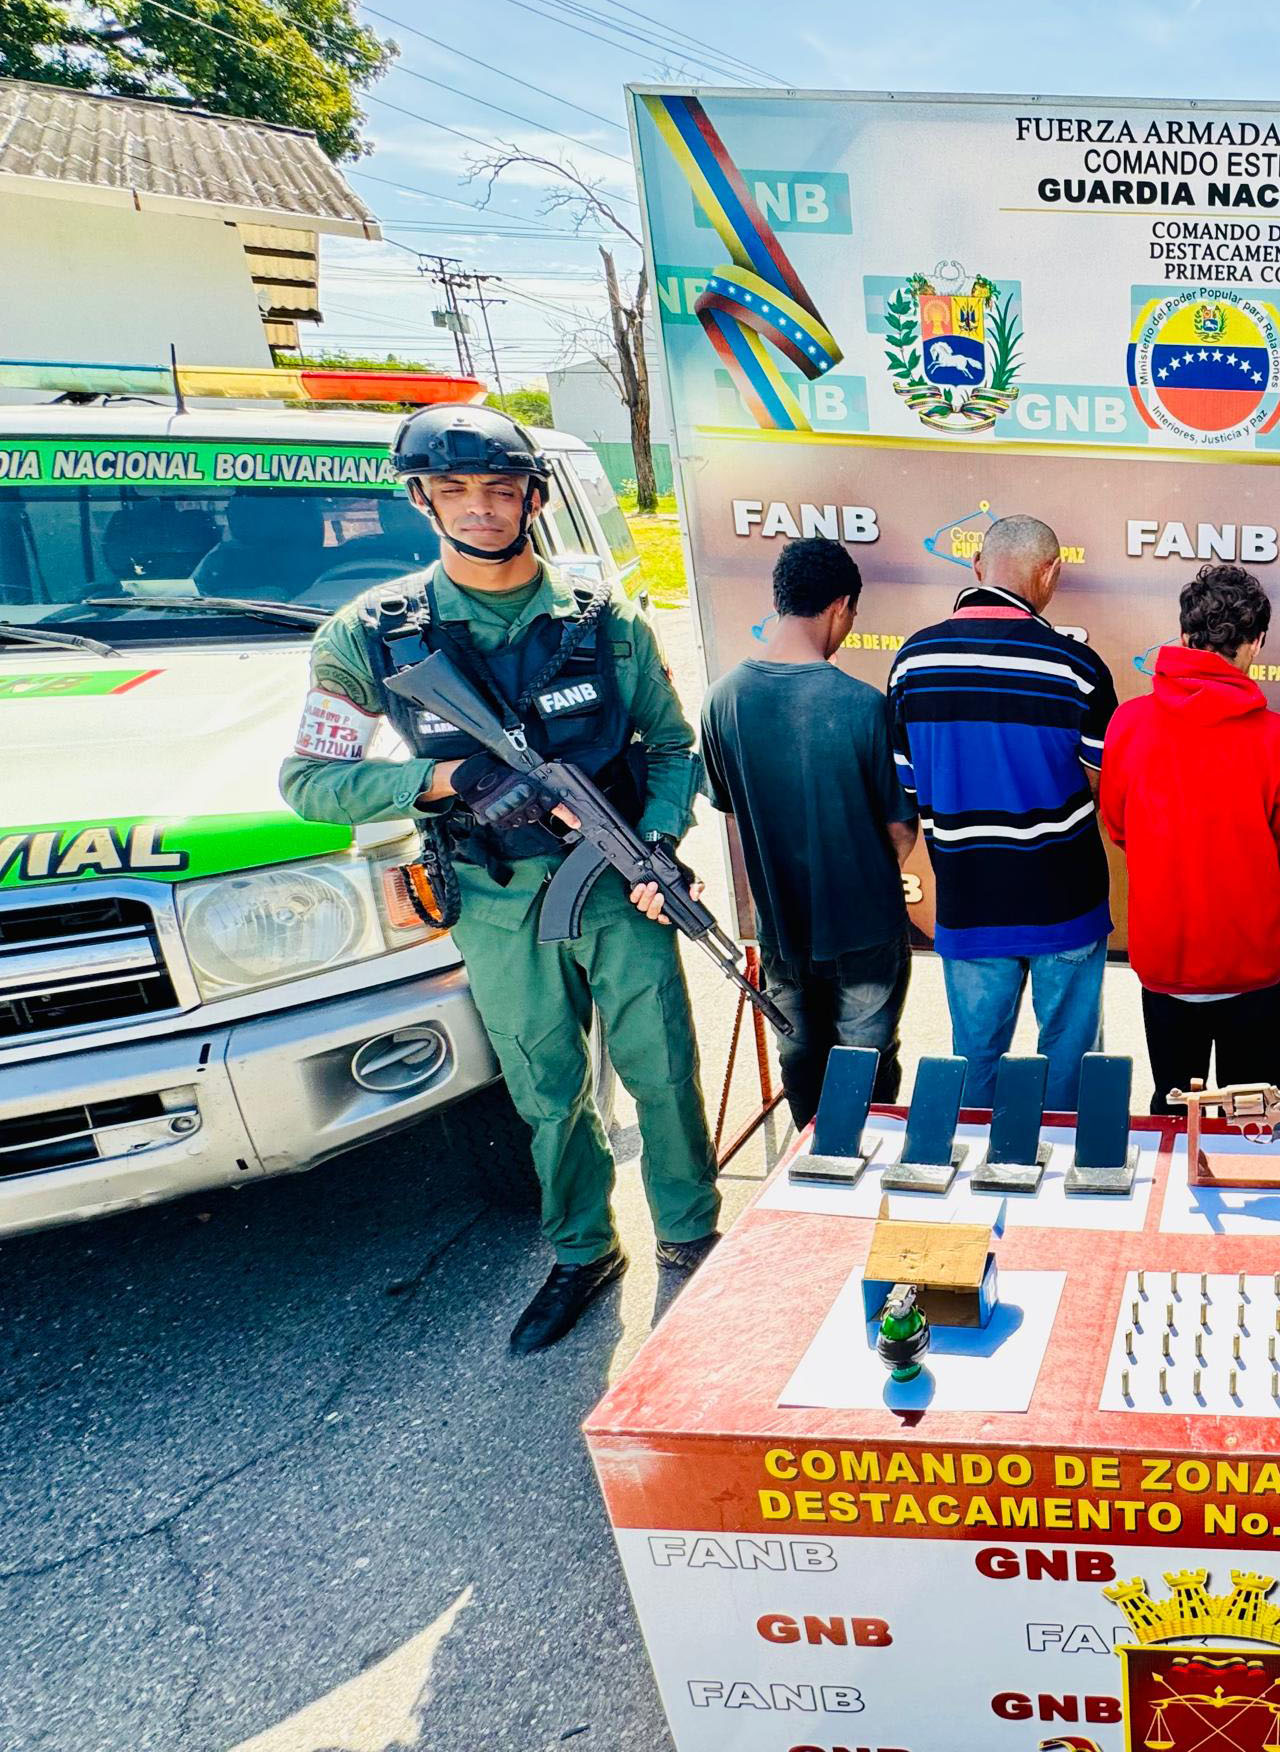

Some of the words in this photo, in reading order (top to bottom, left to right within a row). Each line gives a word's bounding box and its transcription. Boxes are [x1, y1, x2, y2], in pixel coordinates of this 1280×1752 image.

[1015, 117, 1140, 144] FUERZA
[1084, 149, 1219, 178] COMANDO
[1038, 178, 1196, 207] GUARDIA
[1152, 221, 1261, 242] COMANDO
[1164, 263, 1253, 282] PRIMERA
[1137, 327, 1154, 385] Ministerio
[1153, 308, 1167, 327] del
[1165, 291, 1197, 312] Poder
[1199, 287, 1243, 304] Popular
[1242, 301, 1264, 325] para
[1262, 323, 1280, 389] Relaciones
[1016, 394, 1127, 436] GNB
[1201, 429, 1242, 445] Justicia
[1244, 425, 1250, 436] y
[1250, 409, 1268, 428] Paz
[53, 451, 202, 481] NACIONAL
[216, 453, 396, 484] BOLIVARIANA
[733, 500, 879, 543] FANB
[1127, 520, 1278, 562] FANB
[539, 683, 598, 713] FANB
[763, 1448, 1034, 1486] COMANDO
[1055, 1456, 1122, 1491] DE
[758, 1490, 1183, 1534] DESTACAMENTO
[648, 1536, 838, 1573] FANB
[975, 1547, 1117, 1582] GNB
[757, 1614, 894, 1648] GNB
[687, 1680, 866, 1714] FANB
[991, 1691, 1123, 1724] GNB
